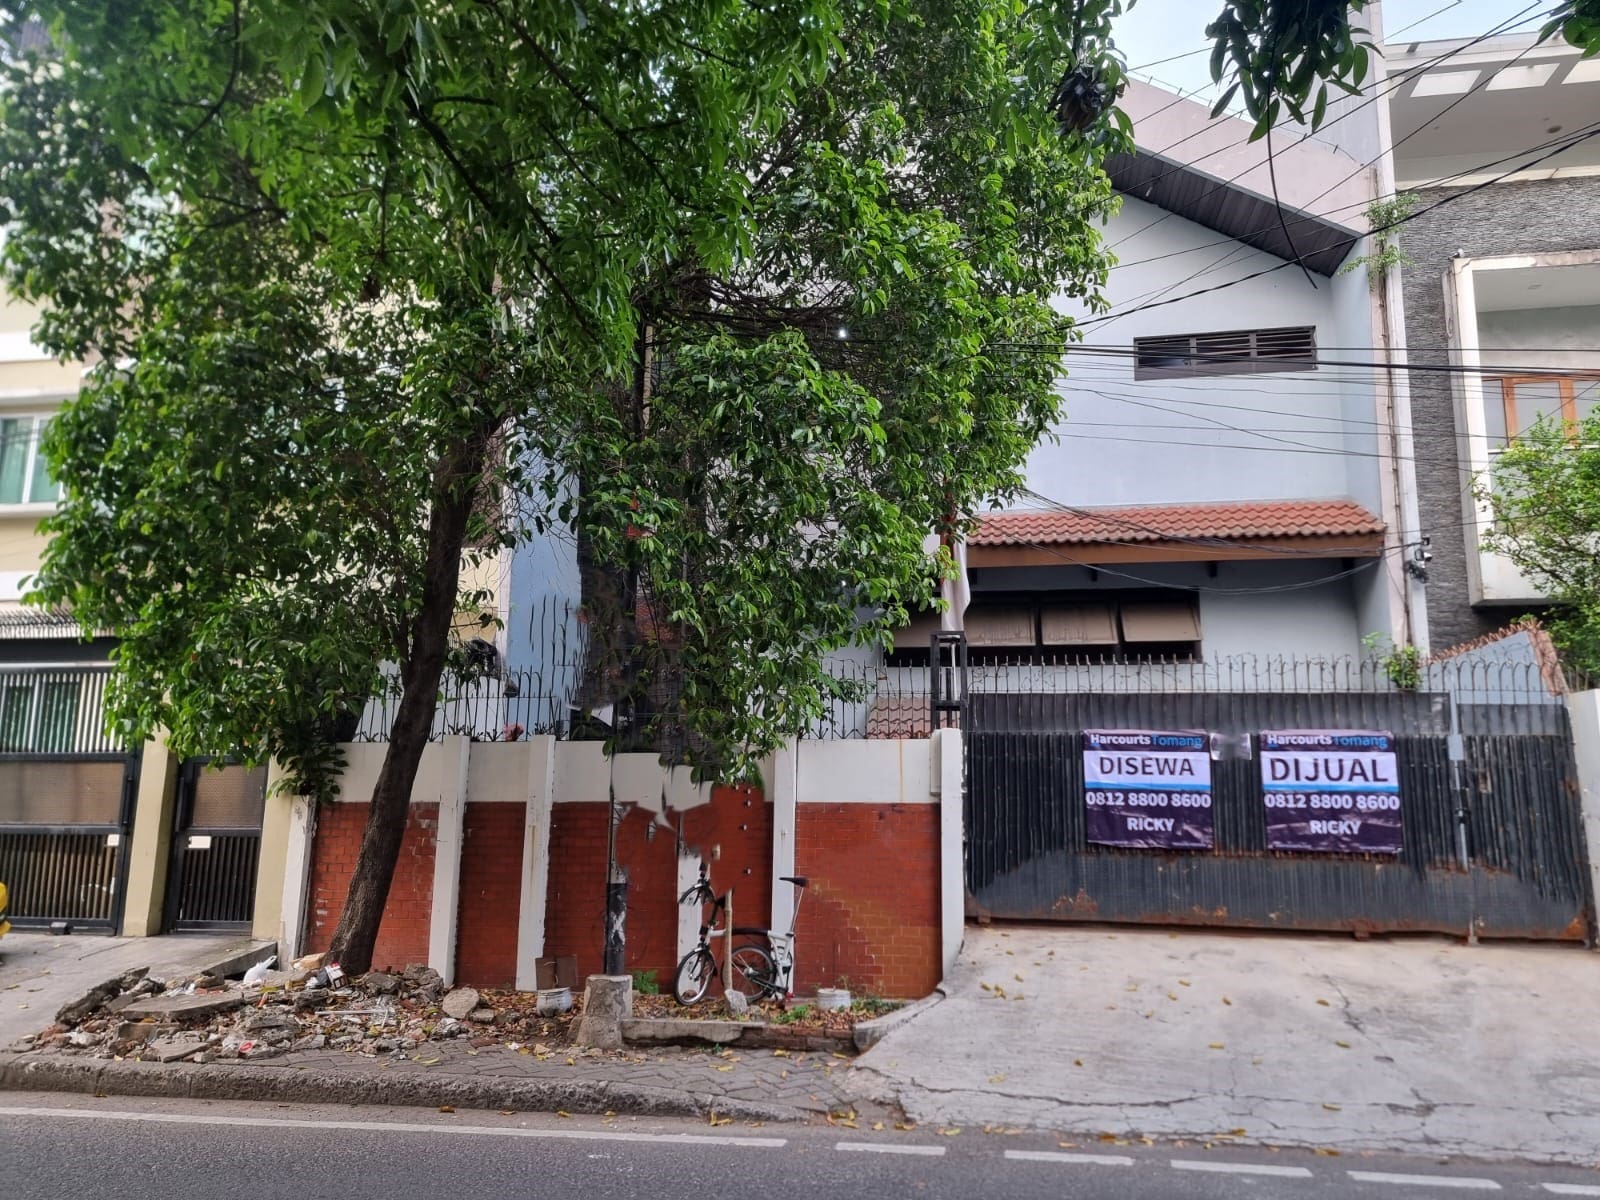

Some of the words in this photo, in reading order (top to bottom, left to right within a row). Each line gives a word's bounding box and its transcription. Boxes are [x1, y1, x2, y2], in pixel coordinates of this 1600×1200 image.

[1090, 734, 1151, 745] Harcourts
[1267, 734, 1333, 745] Harcourts
[1100, 756, 1195, 776] DISEWA
[1270, 758, 1389, 782] DIJUAL
[1085, 791, 1125, 806] 0812
[1128, 793, 1168, 806] 8800
[1171, 793, 1212, 808] 8600
[1264, 794, 1307, 808] 0812
[1310, 794, 1353, 809] 8800
[1356, 795, 1400, 810] 8600
[1126, 817, 1175, 832] RICKY
[1309, 820, 1362, 835] RICKY
